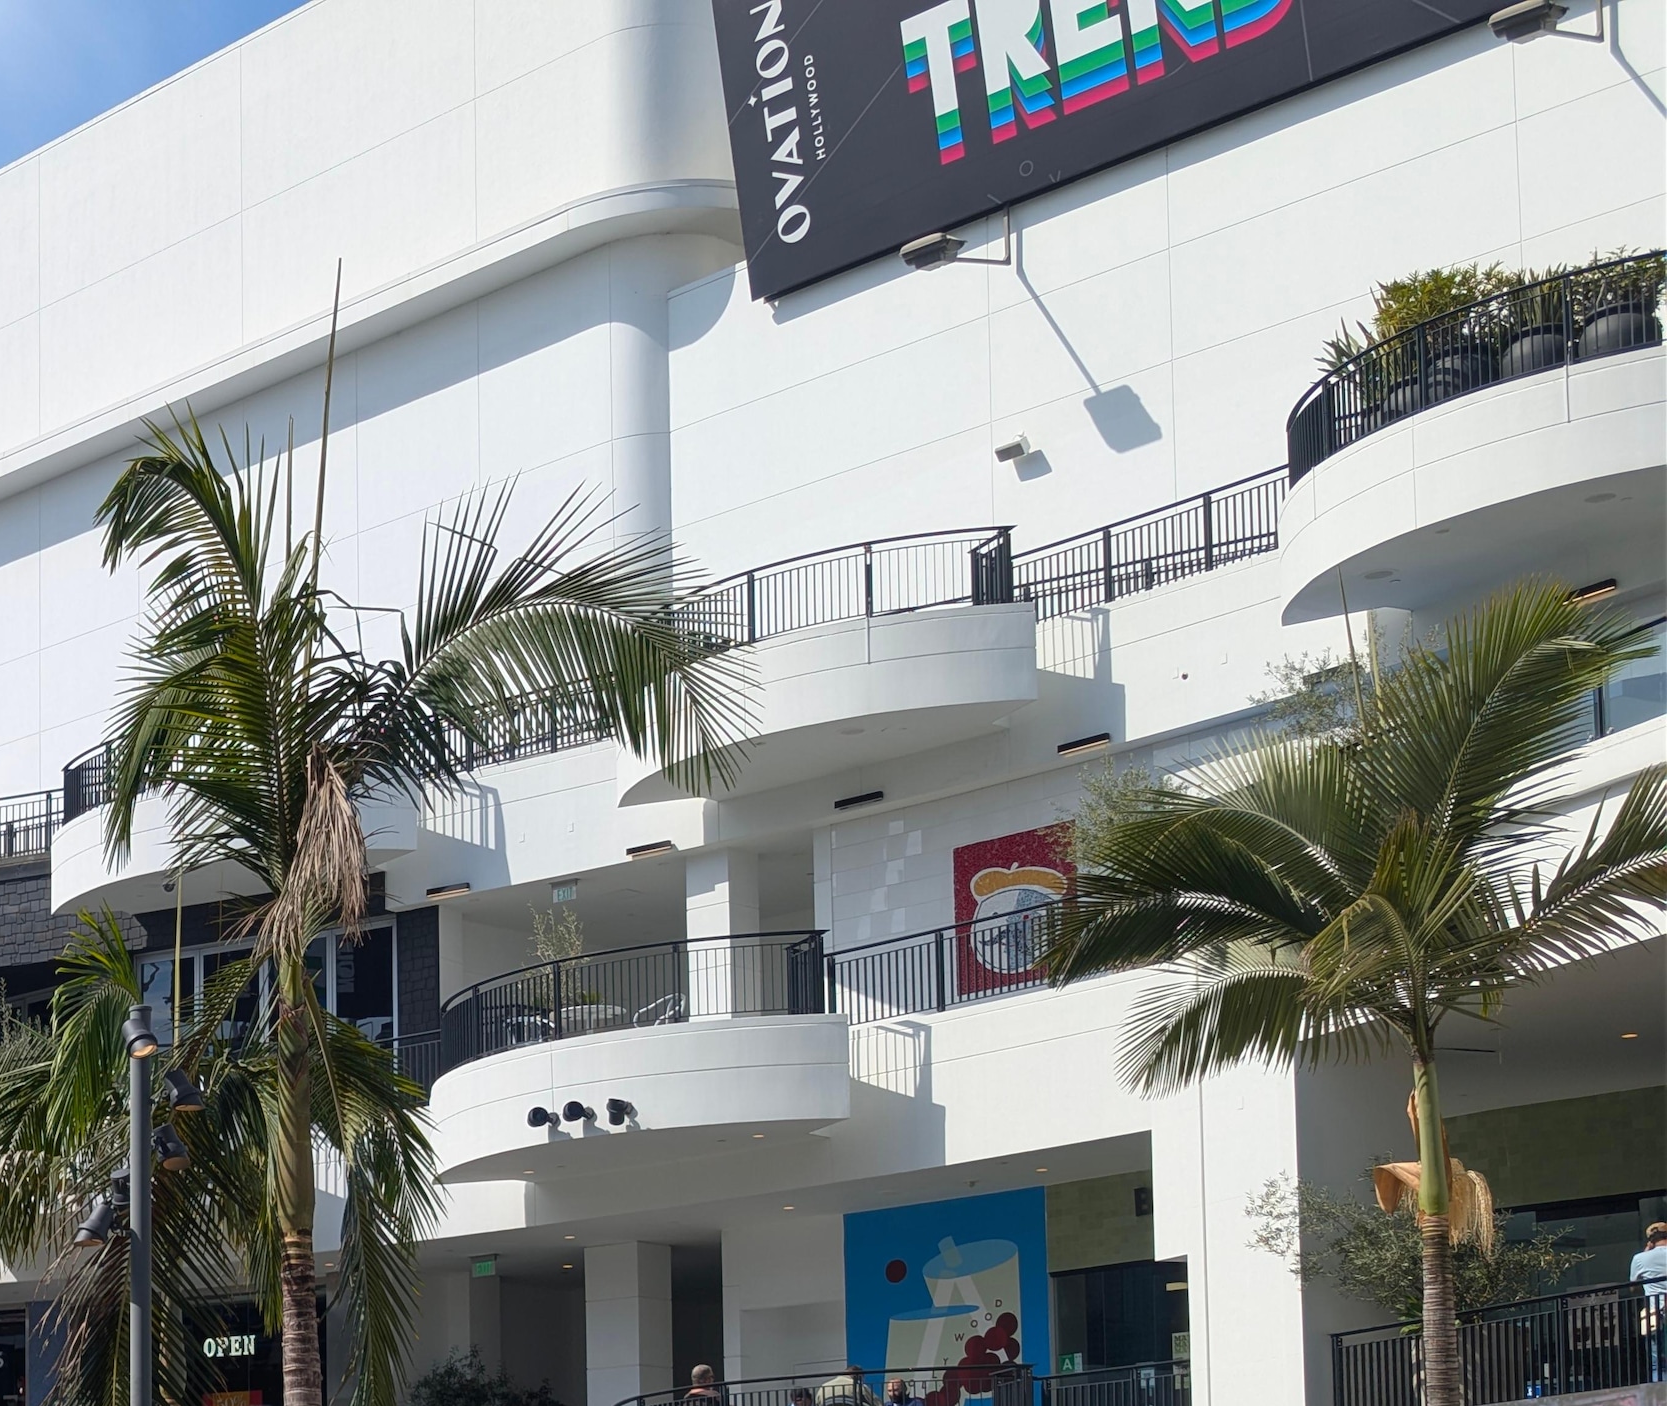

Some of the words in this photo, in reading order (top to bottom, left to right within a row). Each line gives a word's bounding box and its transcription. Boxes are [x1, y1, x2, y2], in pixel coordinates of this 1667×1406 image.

[749, 0, 811, 243] OVATION
[803, 54, 827, 160] HOLLYWOOD
[203, 1334, 256, 1358] OPEN
[1063, 1358, 1073, 1371] A
